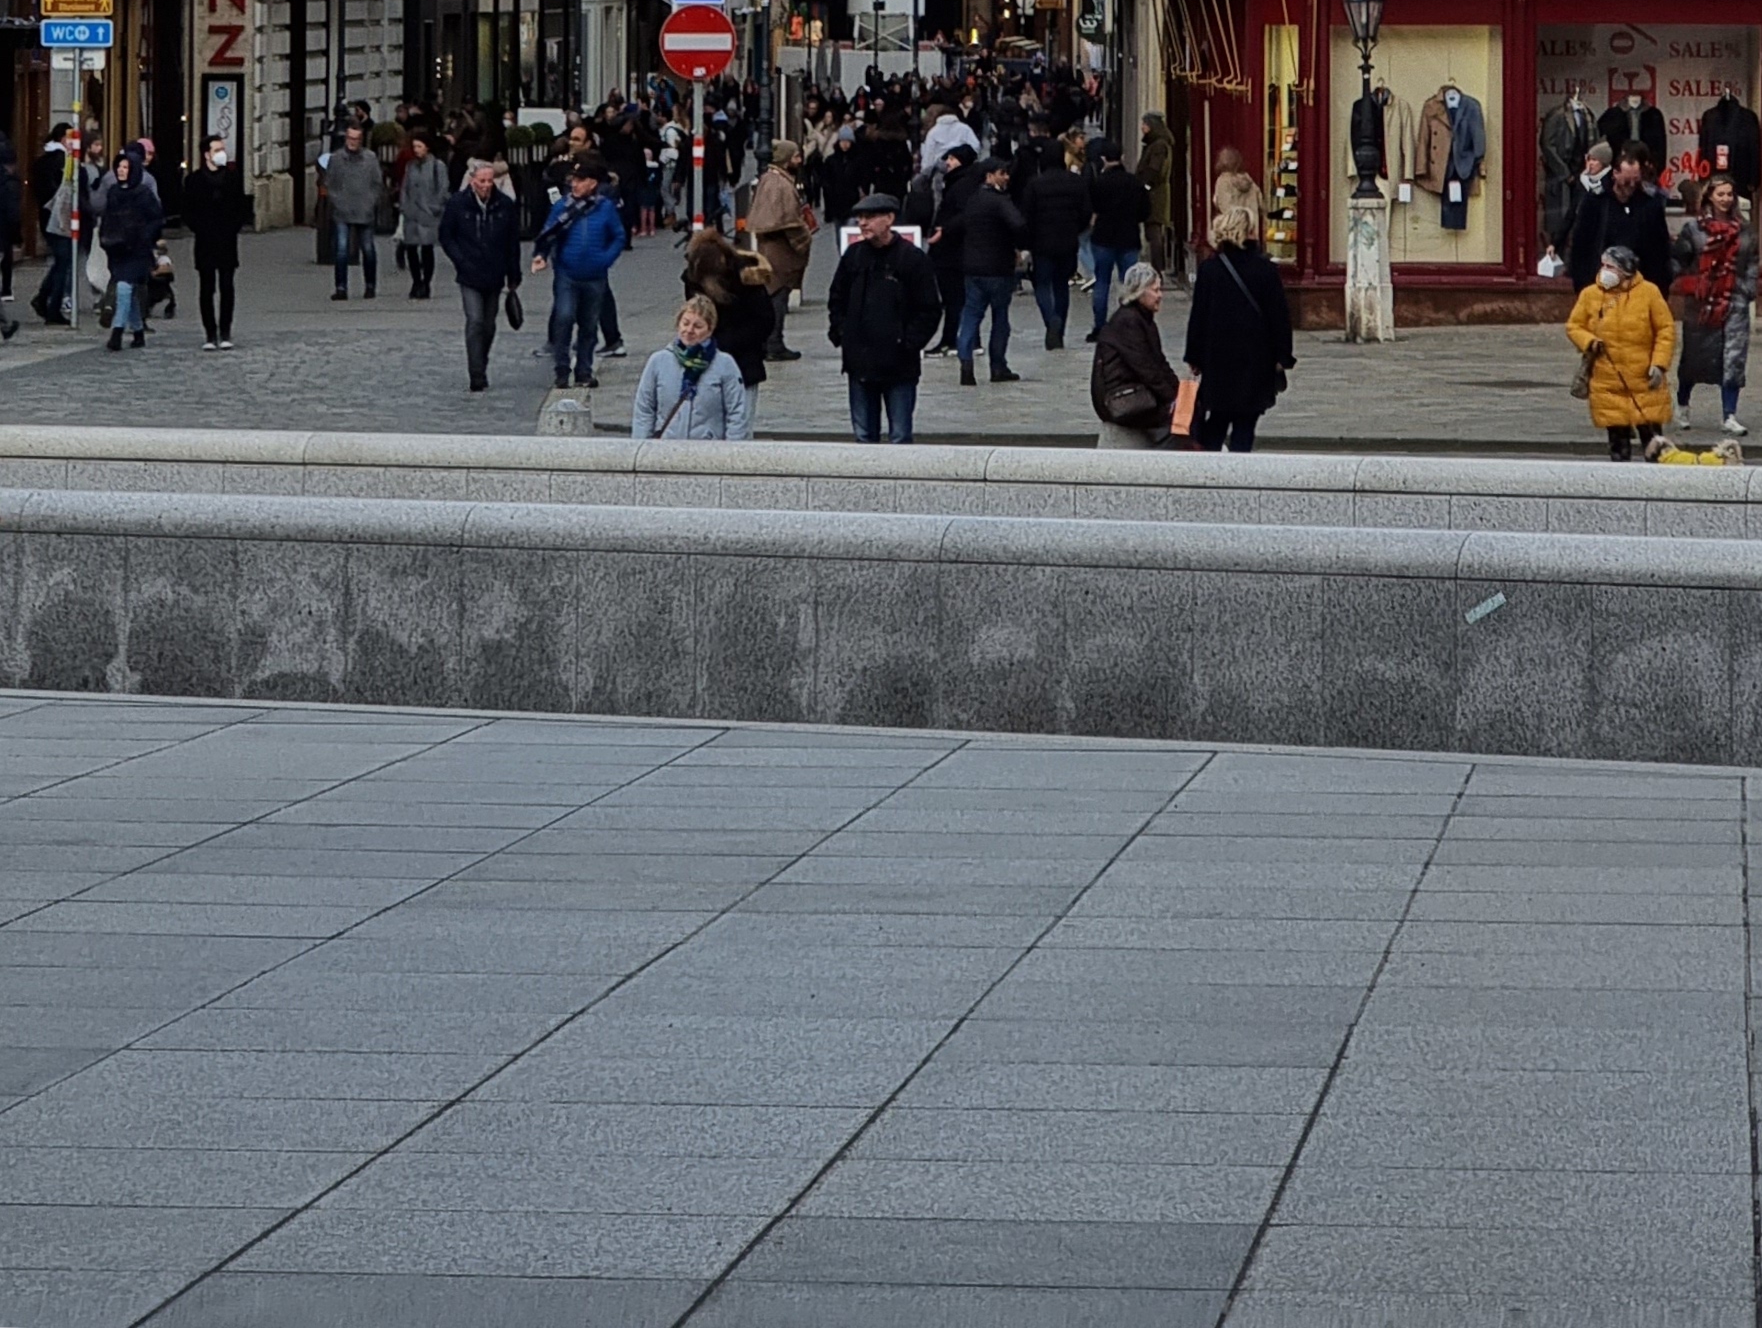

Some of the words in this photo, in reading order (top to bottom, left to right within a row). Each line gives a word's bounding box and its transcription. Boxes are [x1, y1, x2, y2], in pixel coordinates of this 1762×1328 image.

[50, 25, 75, 41] WC
[1538, 40, 1597, 57] ALE%
[1669, 41, 1742, 58] SALE%
[1538, 77, 1597, 95] ALE%
[1669, 79, 1742, 97] SALE%
